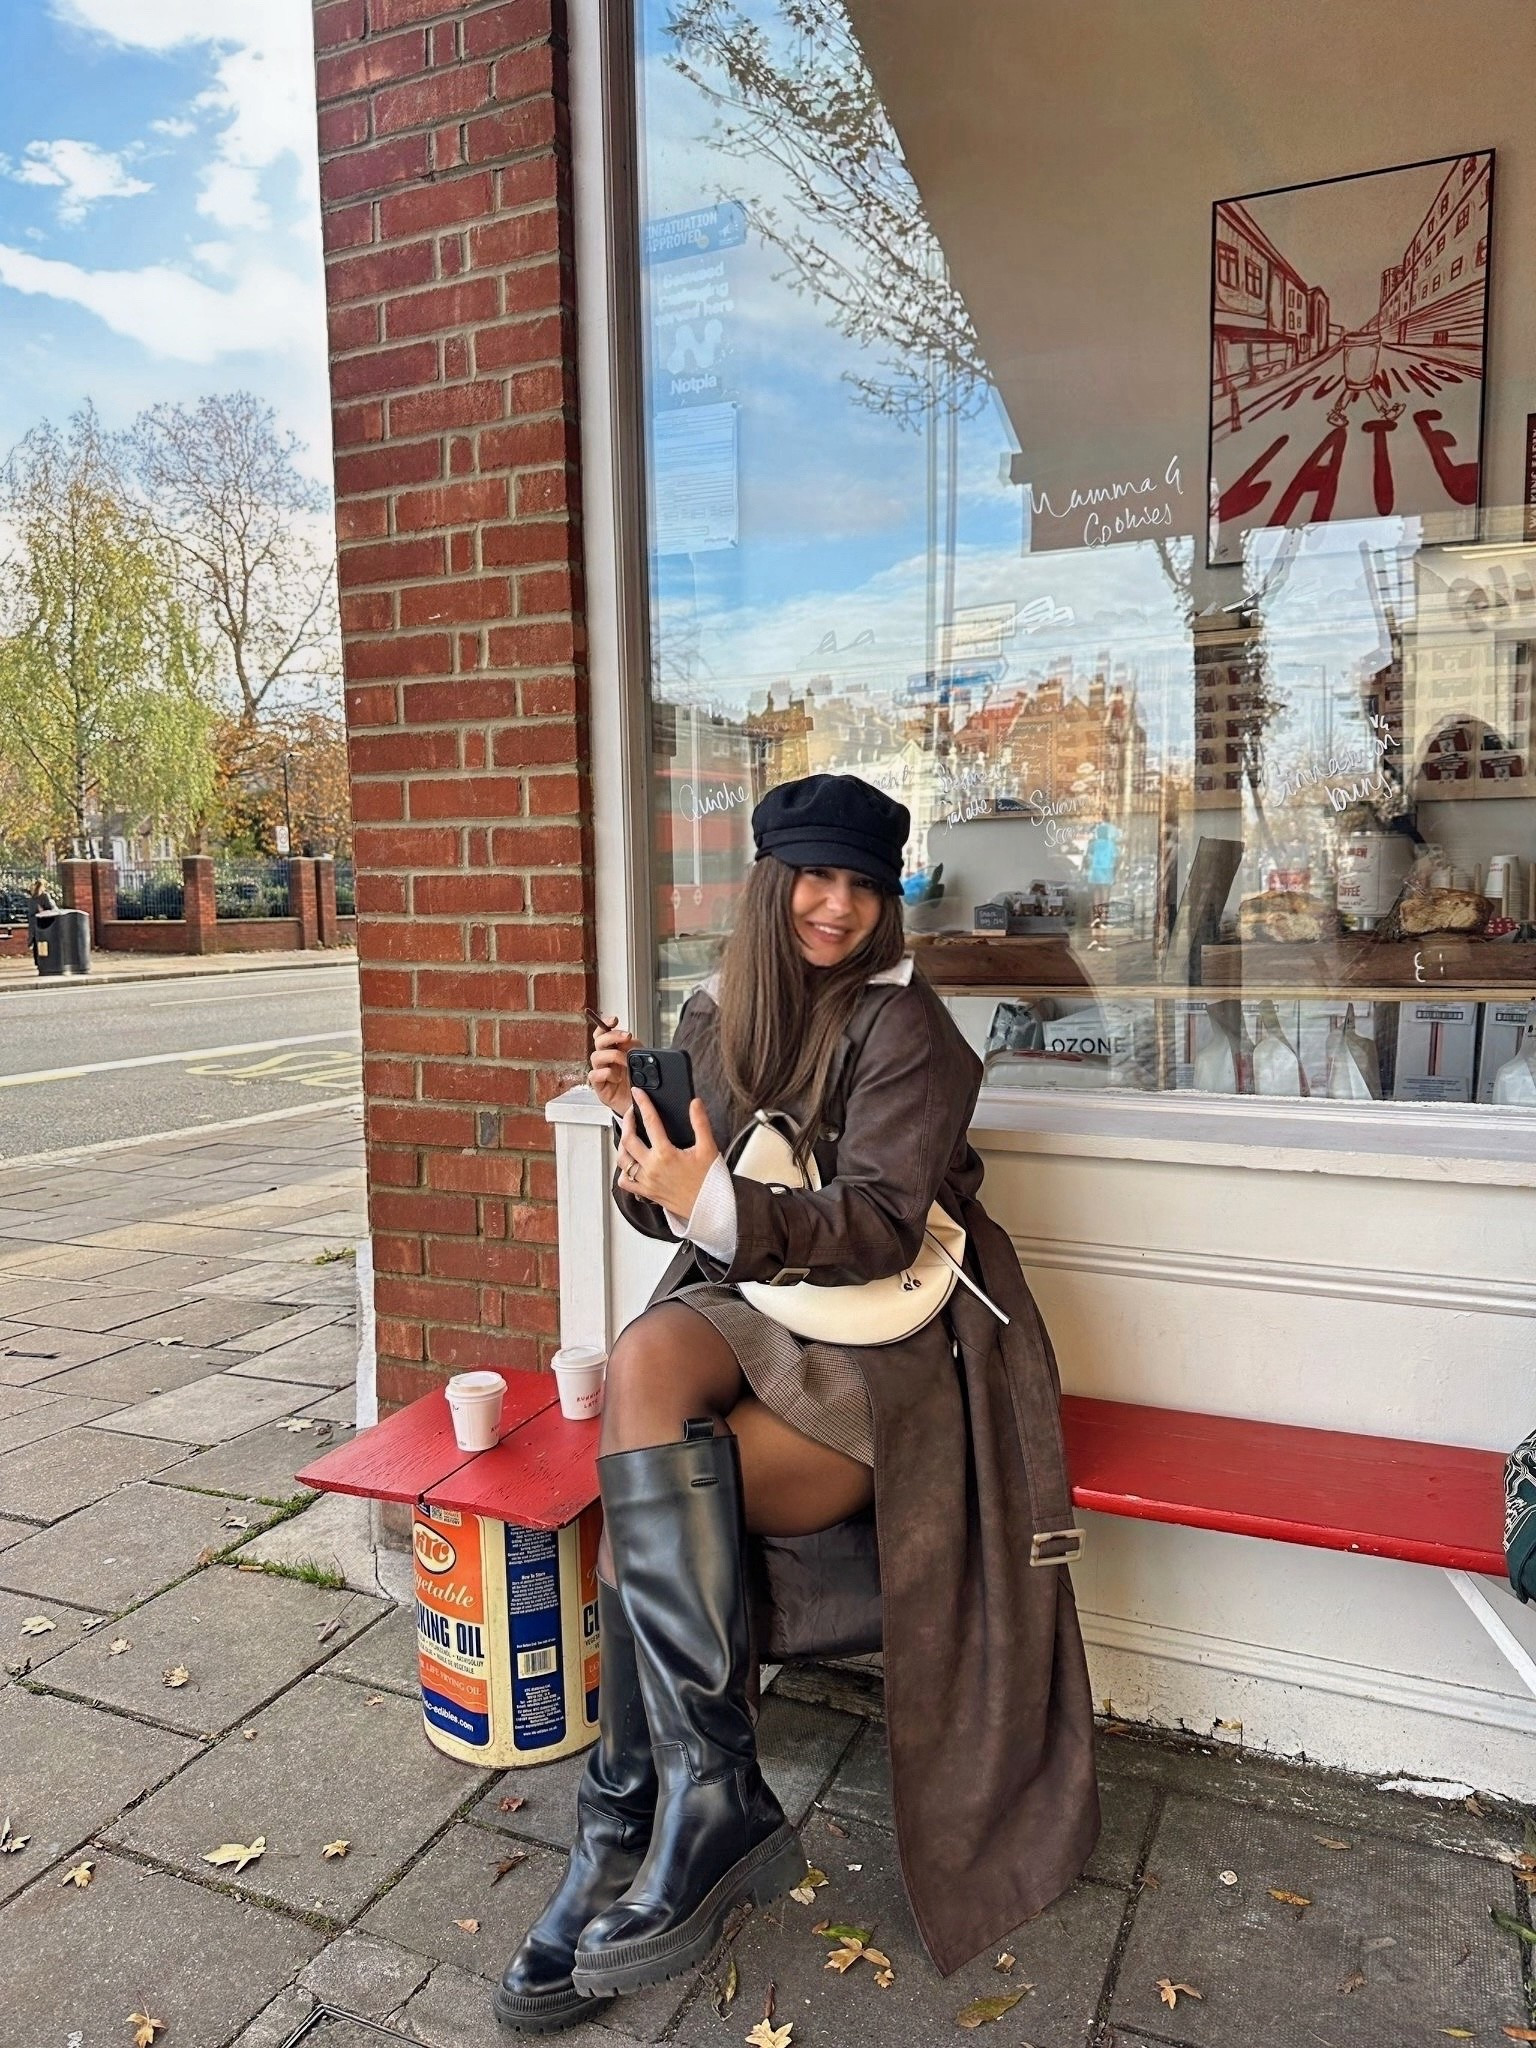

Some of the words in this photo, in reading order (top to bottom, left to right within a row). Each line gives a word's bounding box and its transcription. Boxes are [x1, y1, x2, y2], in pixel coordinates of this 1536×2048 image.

[646, 229, 702, 253] APPROVED
[671, 373, 717, 396] Notpla
[1282, 362, 1464, 411] RUNING
[1219, 409, 1480, 527] LATE
[1083, 503, 1172, 546] Cookies
[679, 782, 750, 822] Quiche
[1051, 1037, 1127, 1054] OZONE
[416, 1600, 450, 1649] KING
[456, 1622, 485, 1659] OIL
[466, 1684, 483, 1696] OIL
